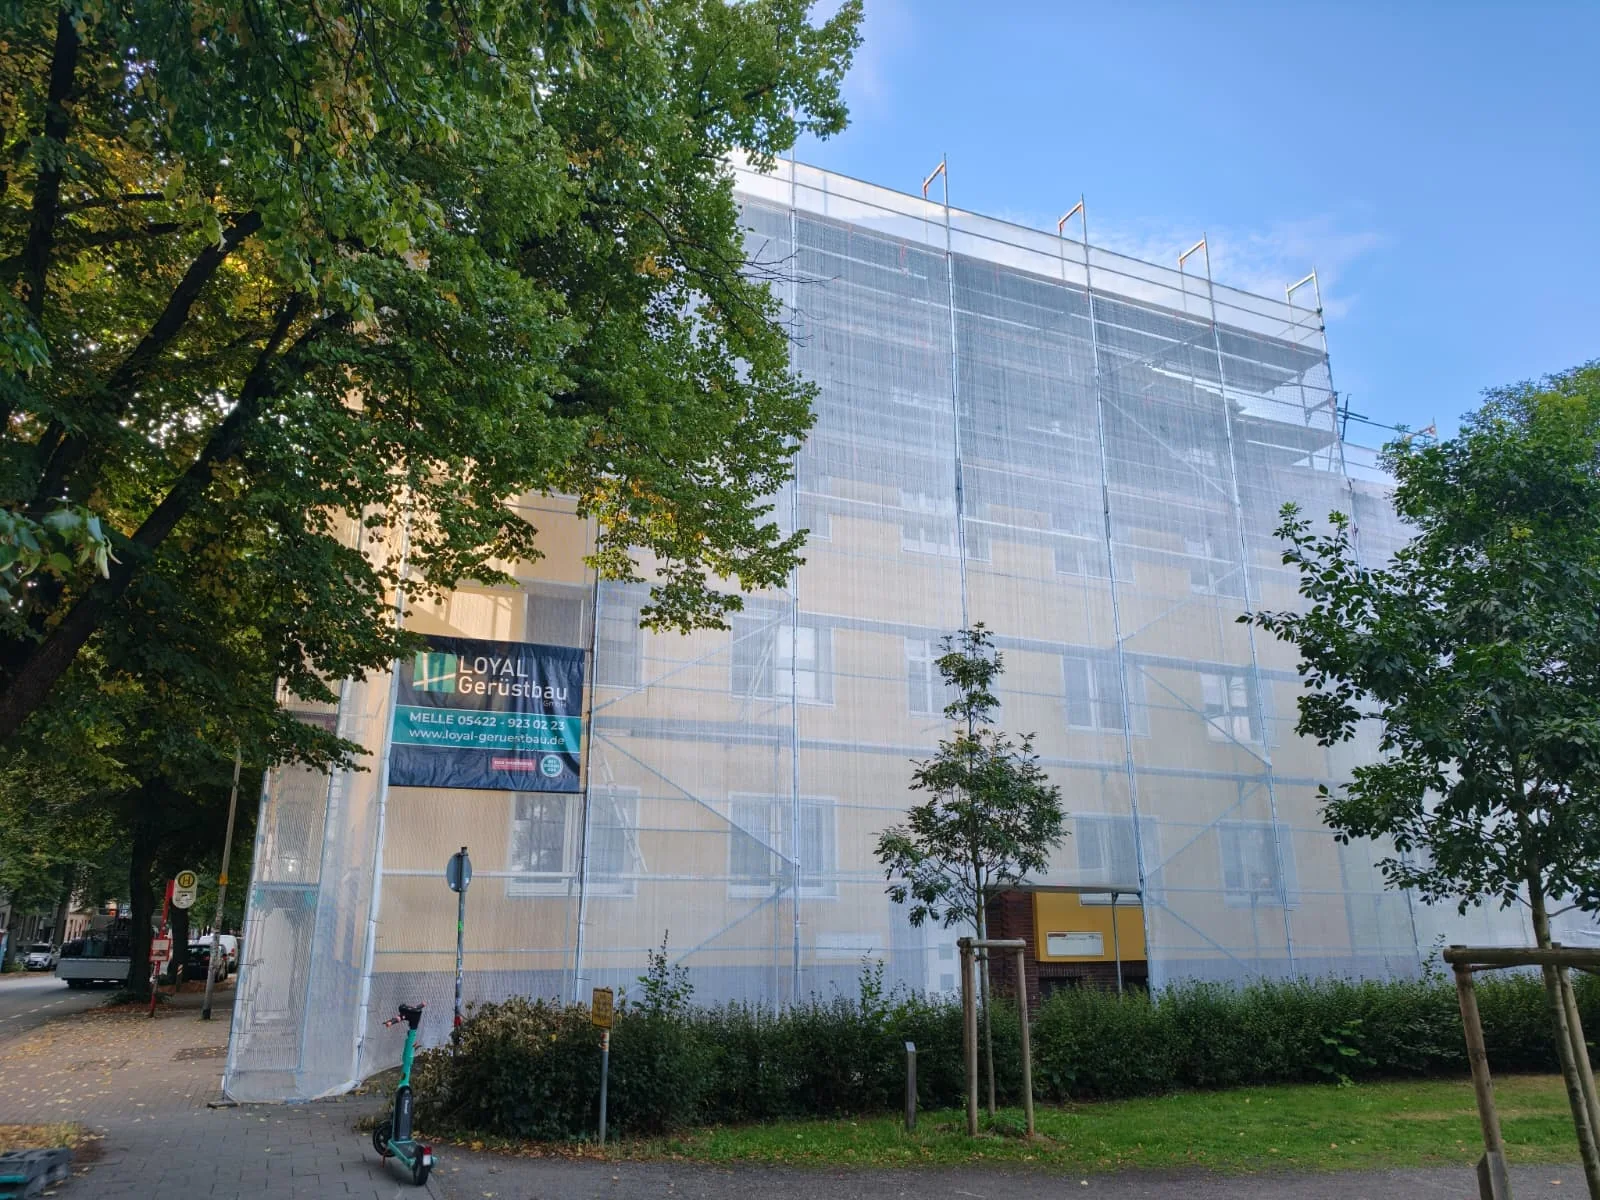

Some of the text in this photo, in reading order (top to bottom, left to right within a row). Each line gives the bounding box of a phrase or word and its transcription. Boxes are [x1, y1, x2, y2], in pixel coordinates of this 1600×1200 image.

[460, 655, 528, 677] LOYAL
[458, 675, 567, 700] Gerüstbau
[409, 712, 454, 724] MELLE
[457, 716, 497, 727] 05422
[508, 718, 530, 728] 923
[533, 720, 547, 730] 02
[551, 721, 565, 730] 23
[409, 729, 565, 745] www.loyal-geruestbau.de
